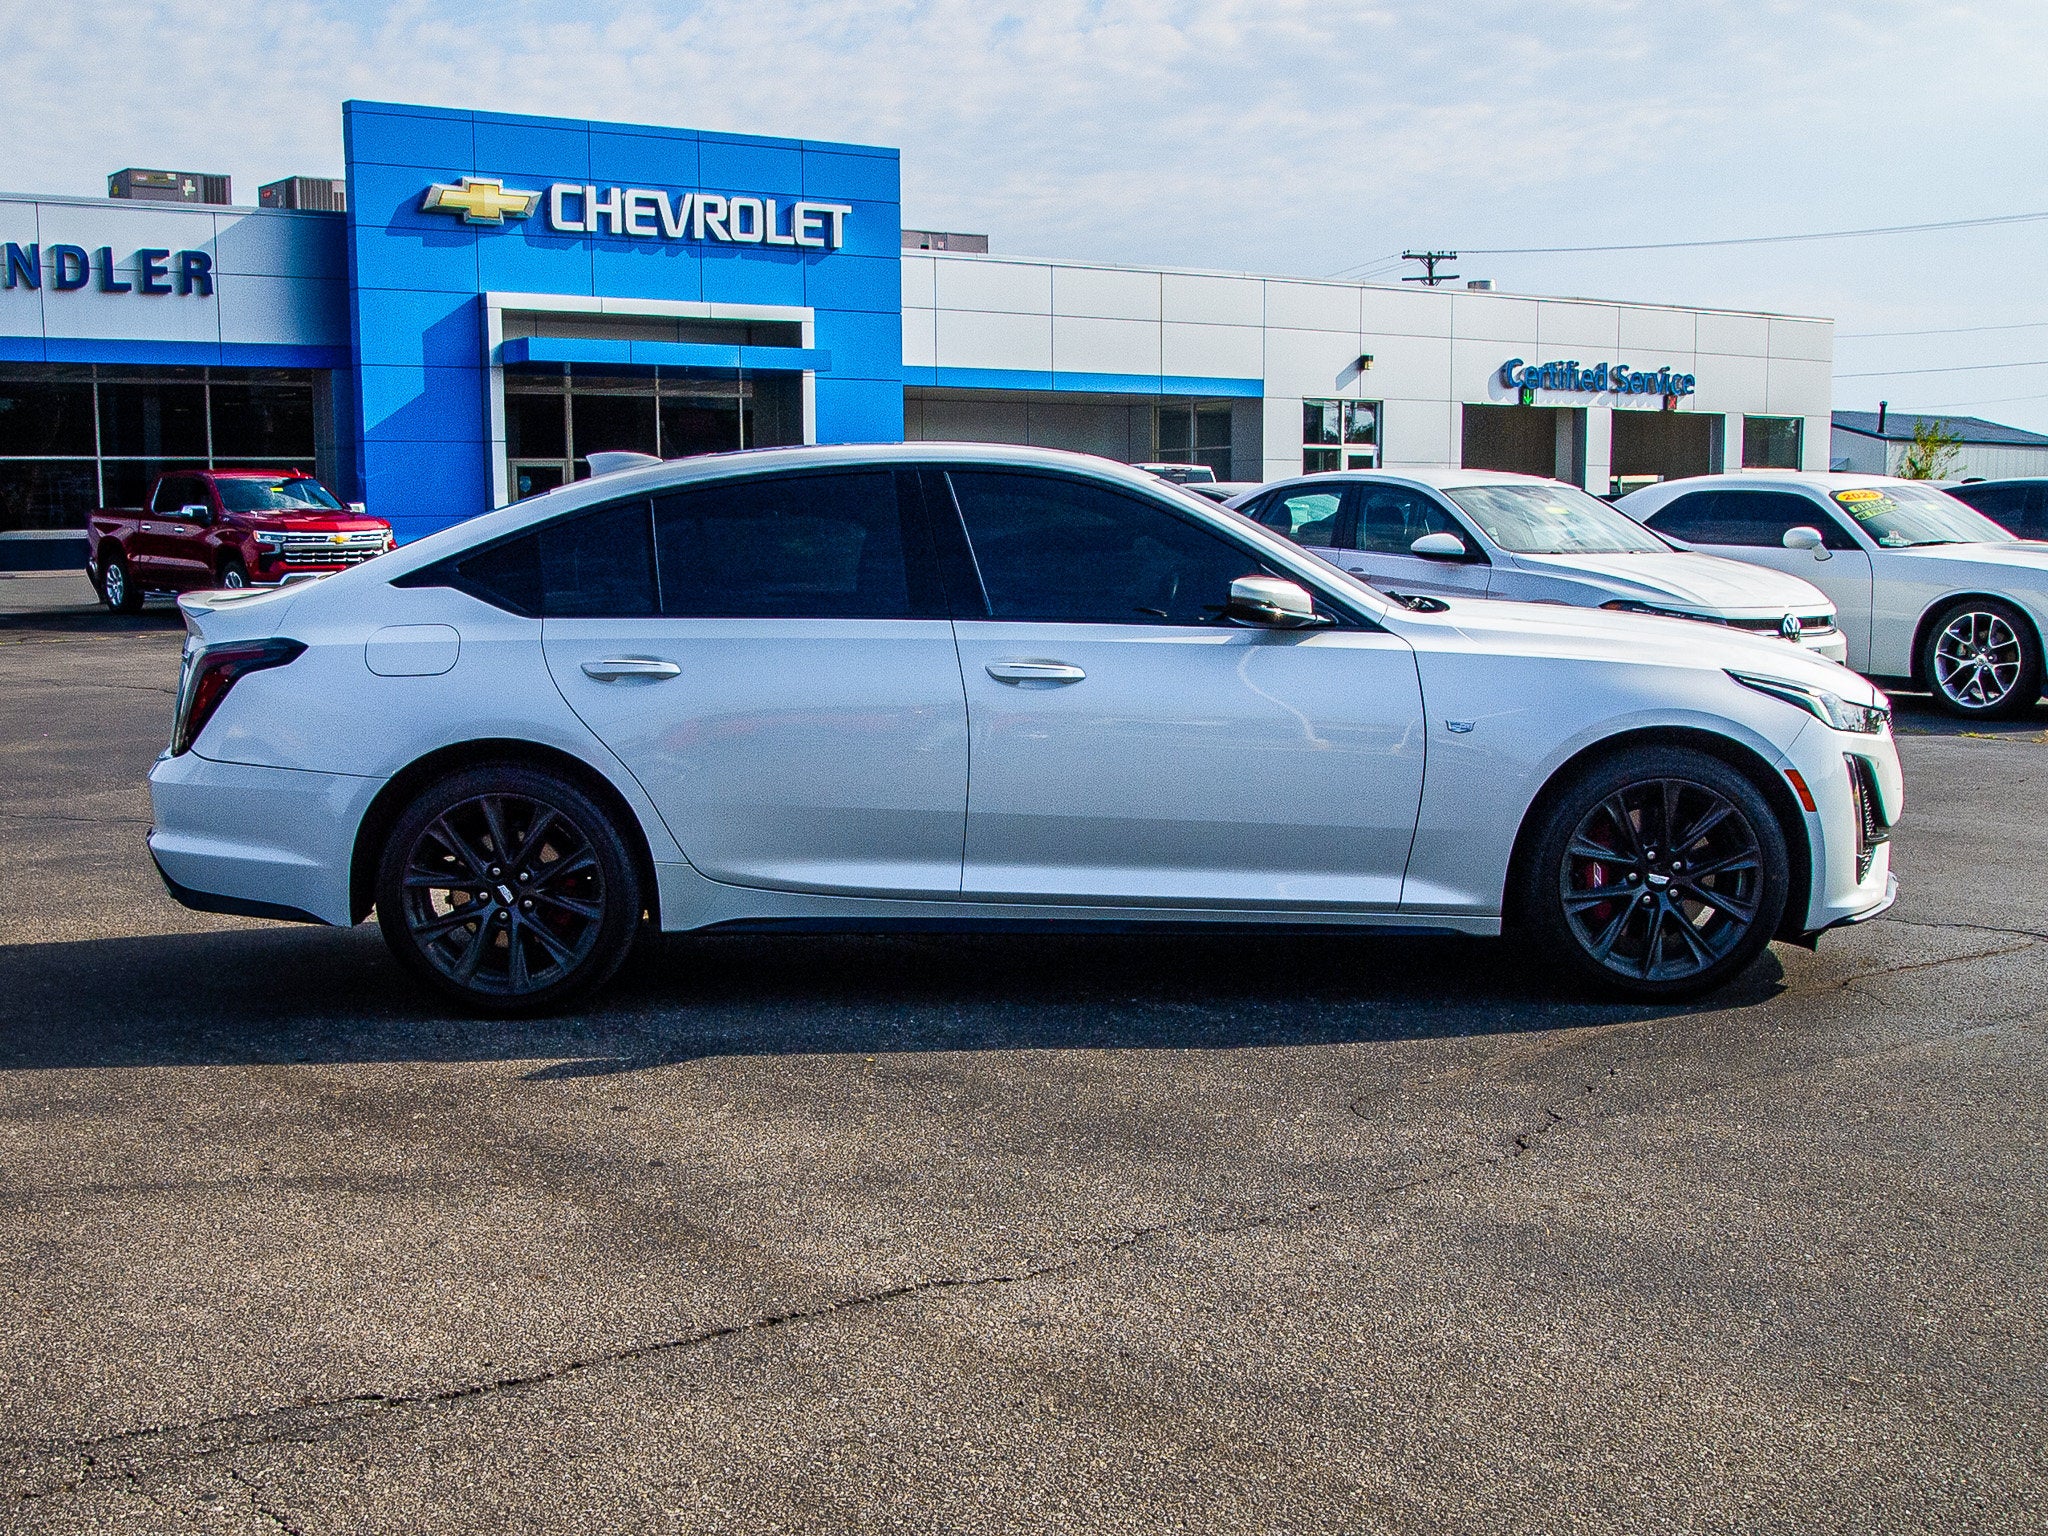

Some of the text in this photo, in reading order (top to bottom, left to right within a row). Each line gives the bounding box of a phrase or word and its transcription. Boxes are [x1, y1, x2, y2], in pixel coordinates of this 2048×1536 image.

[550, 183, 853, 248] CHEVROLET
[2, 242, 214, 295] NDLER
[1501, 358, 1696, 395] Certified Service
[1842, 491, 1879, 501] 2023
